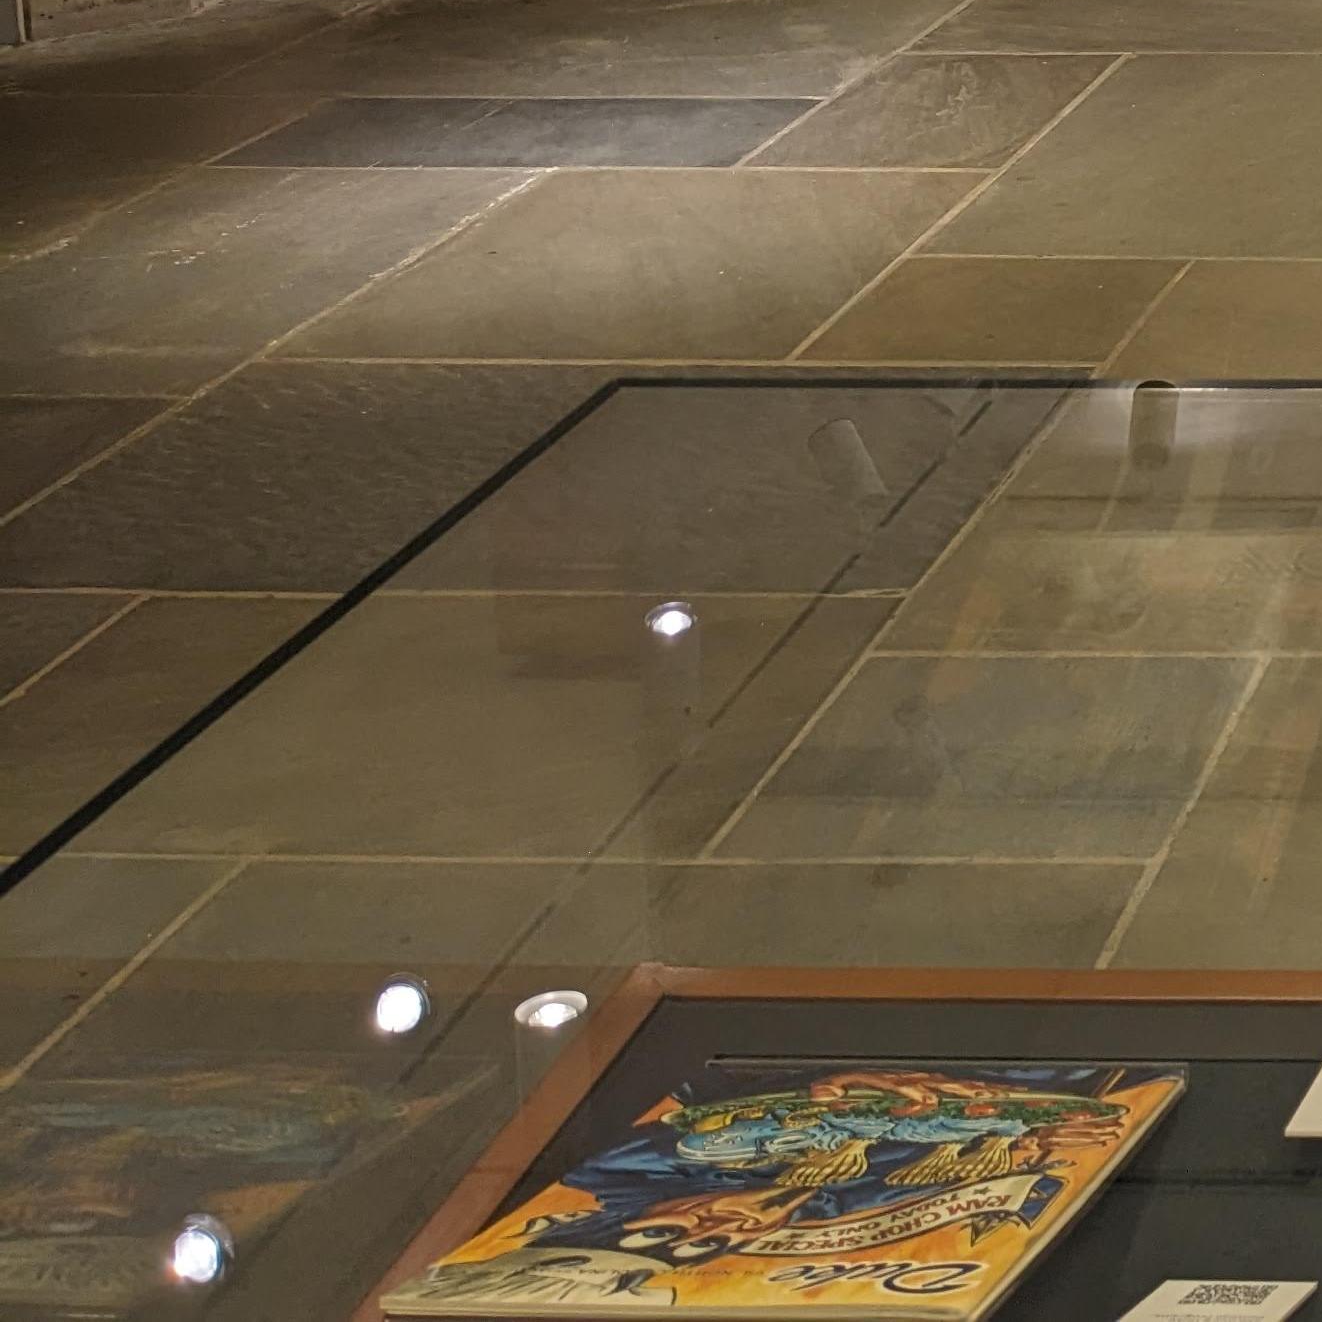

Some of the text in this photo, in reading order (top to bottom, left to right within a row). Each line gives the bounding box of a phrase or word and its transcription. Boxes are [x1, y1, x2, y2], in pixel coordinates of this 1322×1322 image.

[757, 1195, 1011, 1251] RAM CHOP SPECIAL
[822, 1194, 958, 1238] TODAY ONLY
[768, 1263, 985, 1295] Duke
